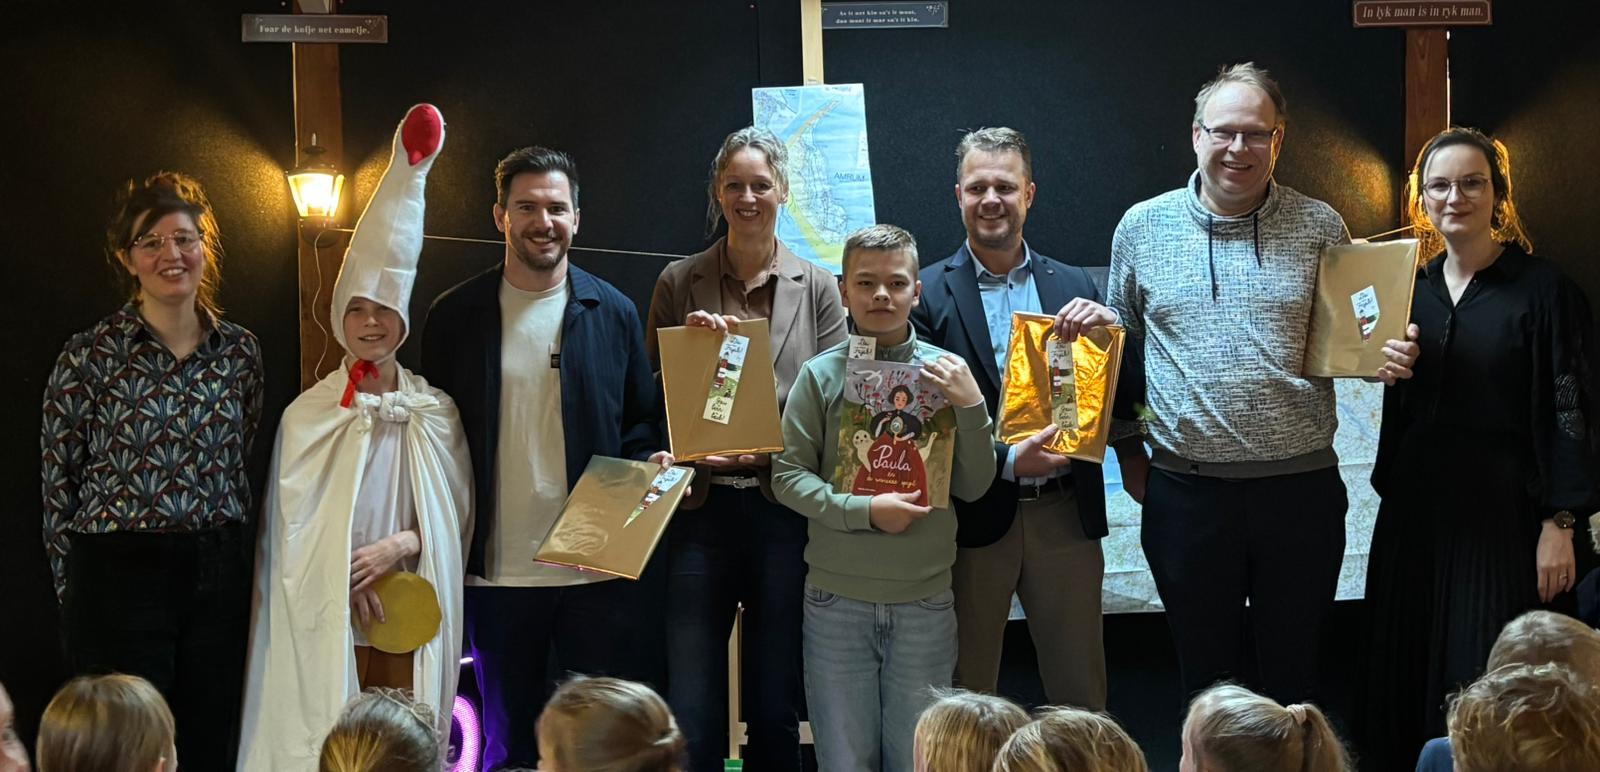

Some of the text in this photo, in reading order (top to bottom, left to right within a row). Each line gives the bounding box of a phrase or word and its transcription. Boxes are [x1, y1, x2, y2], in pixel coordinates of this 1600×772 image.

[1362, 5, 1484, 19] In lyk man is in ryk man.
[259, 25, 280, 33] Foar
[281, 25, 292, 33] de
[834, 171, 865, 181] AMRUM
[873, 445, 912, 471] Paula
